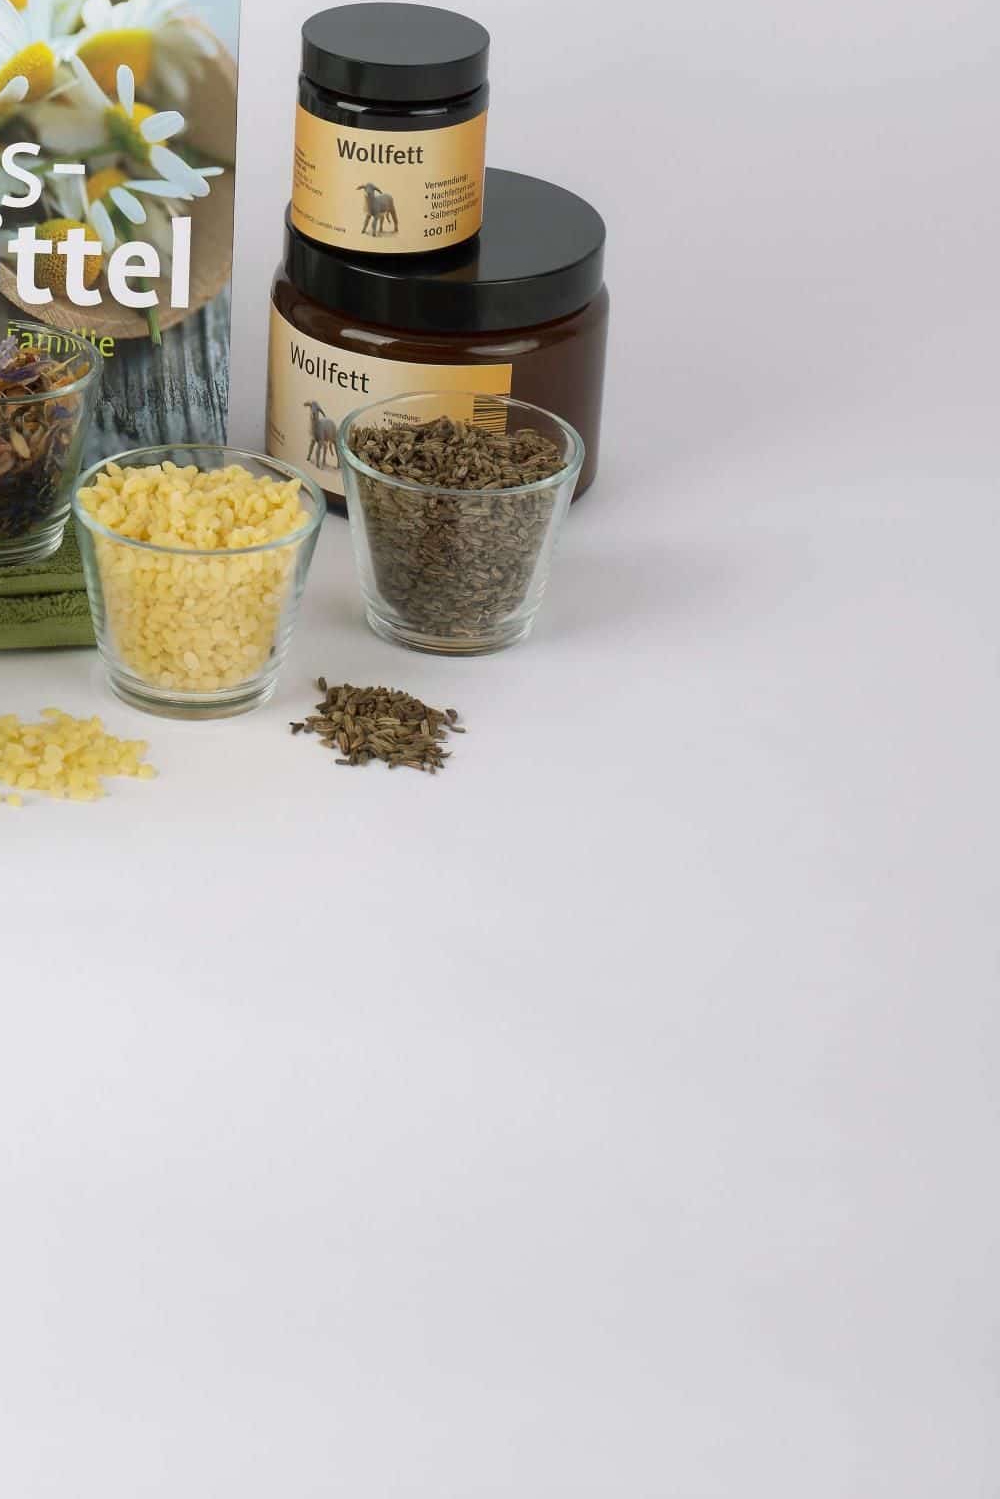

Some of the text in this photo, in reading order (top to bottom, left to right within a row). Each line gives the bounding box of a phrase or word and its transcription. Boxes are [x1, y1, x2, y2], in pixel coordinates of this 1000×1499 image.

[336, 137, 424, 165] Wollfett
[423, 219, 457, 238] 100 ml
[290, 341, 370, 394] Wollfett
